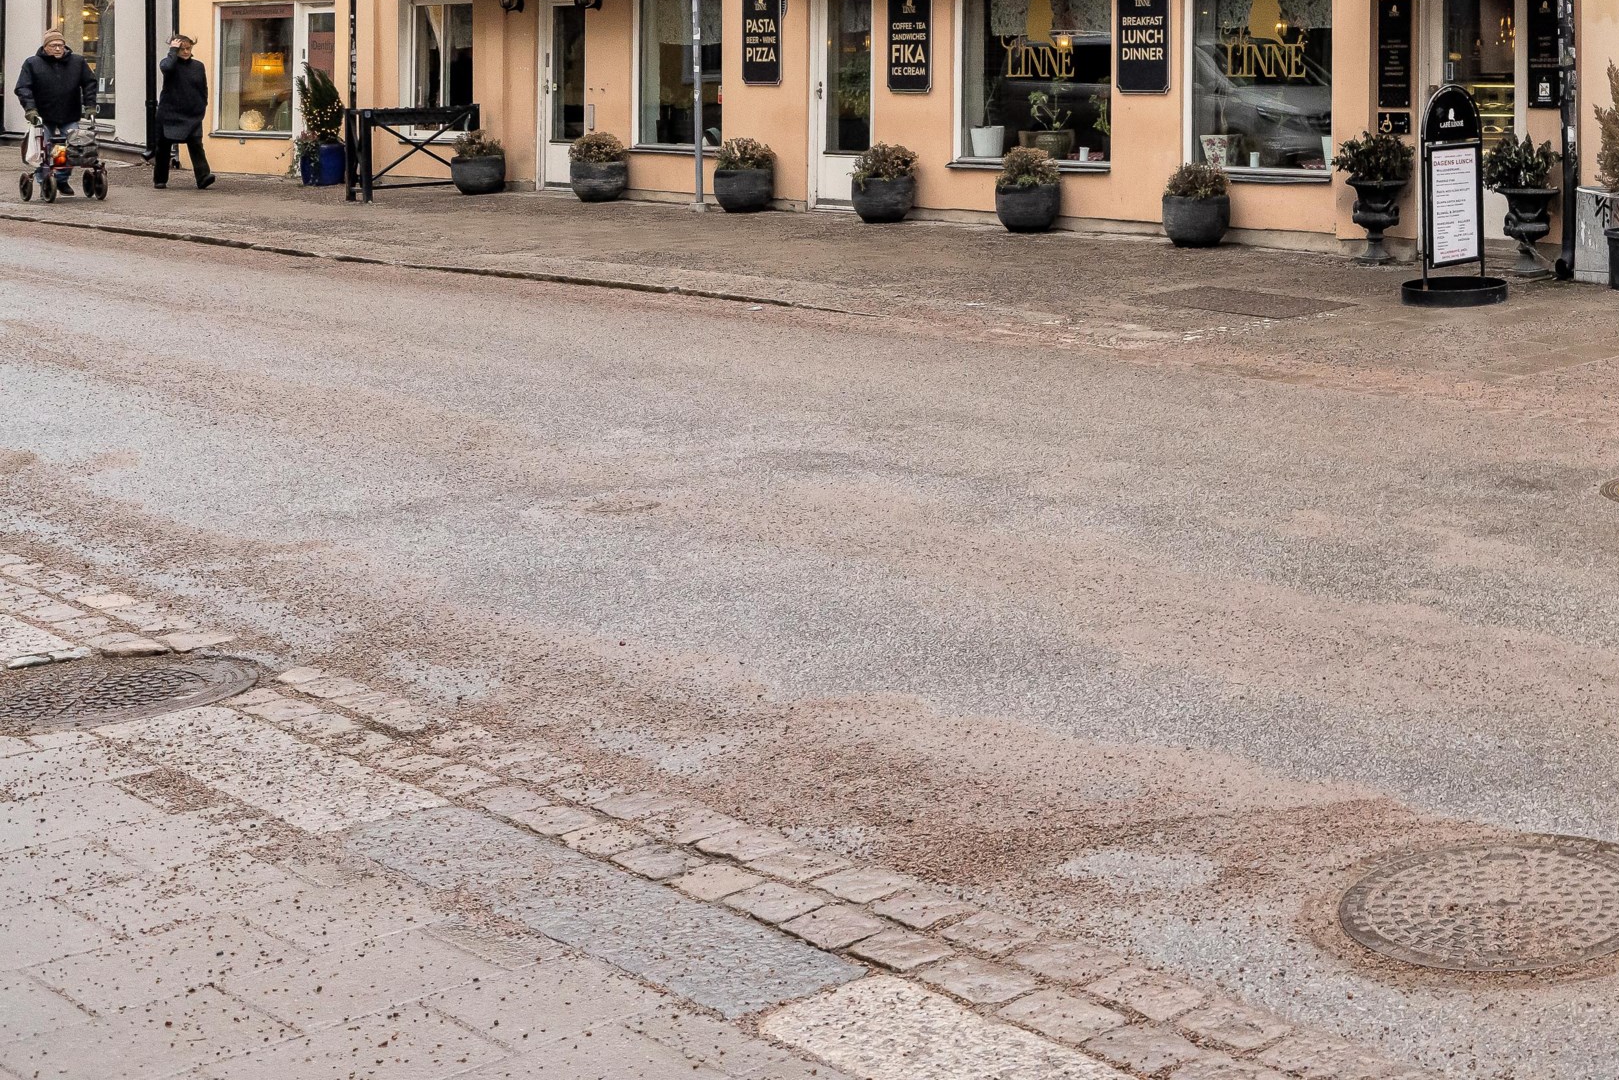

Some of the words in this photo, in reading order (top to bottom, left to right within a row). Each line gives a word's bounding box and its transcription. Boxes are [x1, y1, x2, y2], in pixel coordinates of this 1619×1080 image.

[746, 18, 776, 34] PASTA
[892, 22, 913, 30] COFFEE
[1122, 16, 1163, 26] BREAKFAST
[746, 36, 759, 44] BEER
[763, 36, 776, 44] WINE
[892, 32, 926, 41] SANDWICHES
[1122, 29, 1164, 44] LUNCH
[746, 47, 776, 63] PIZZA
[891, 44, 926, 64] FIKA
[1122, 47, 1164, 61] DINNER
[1225, 34, 1306, 78] LINNÉ
[891, 67, 902, 76] ICE
[903, 67, 926, 76] CREAM
